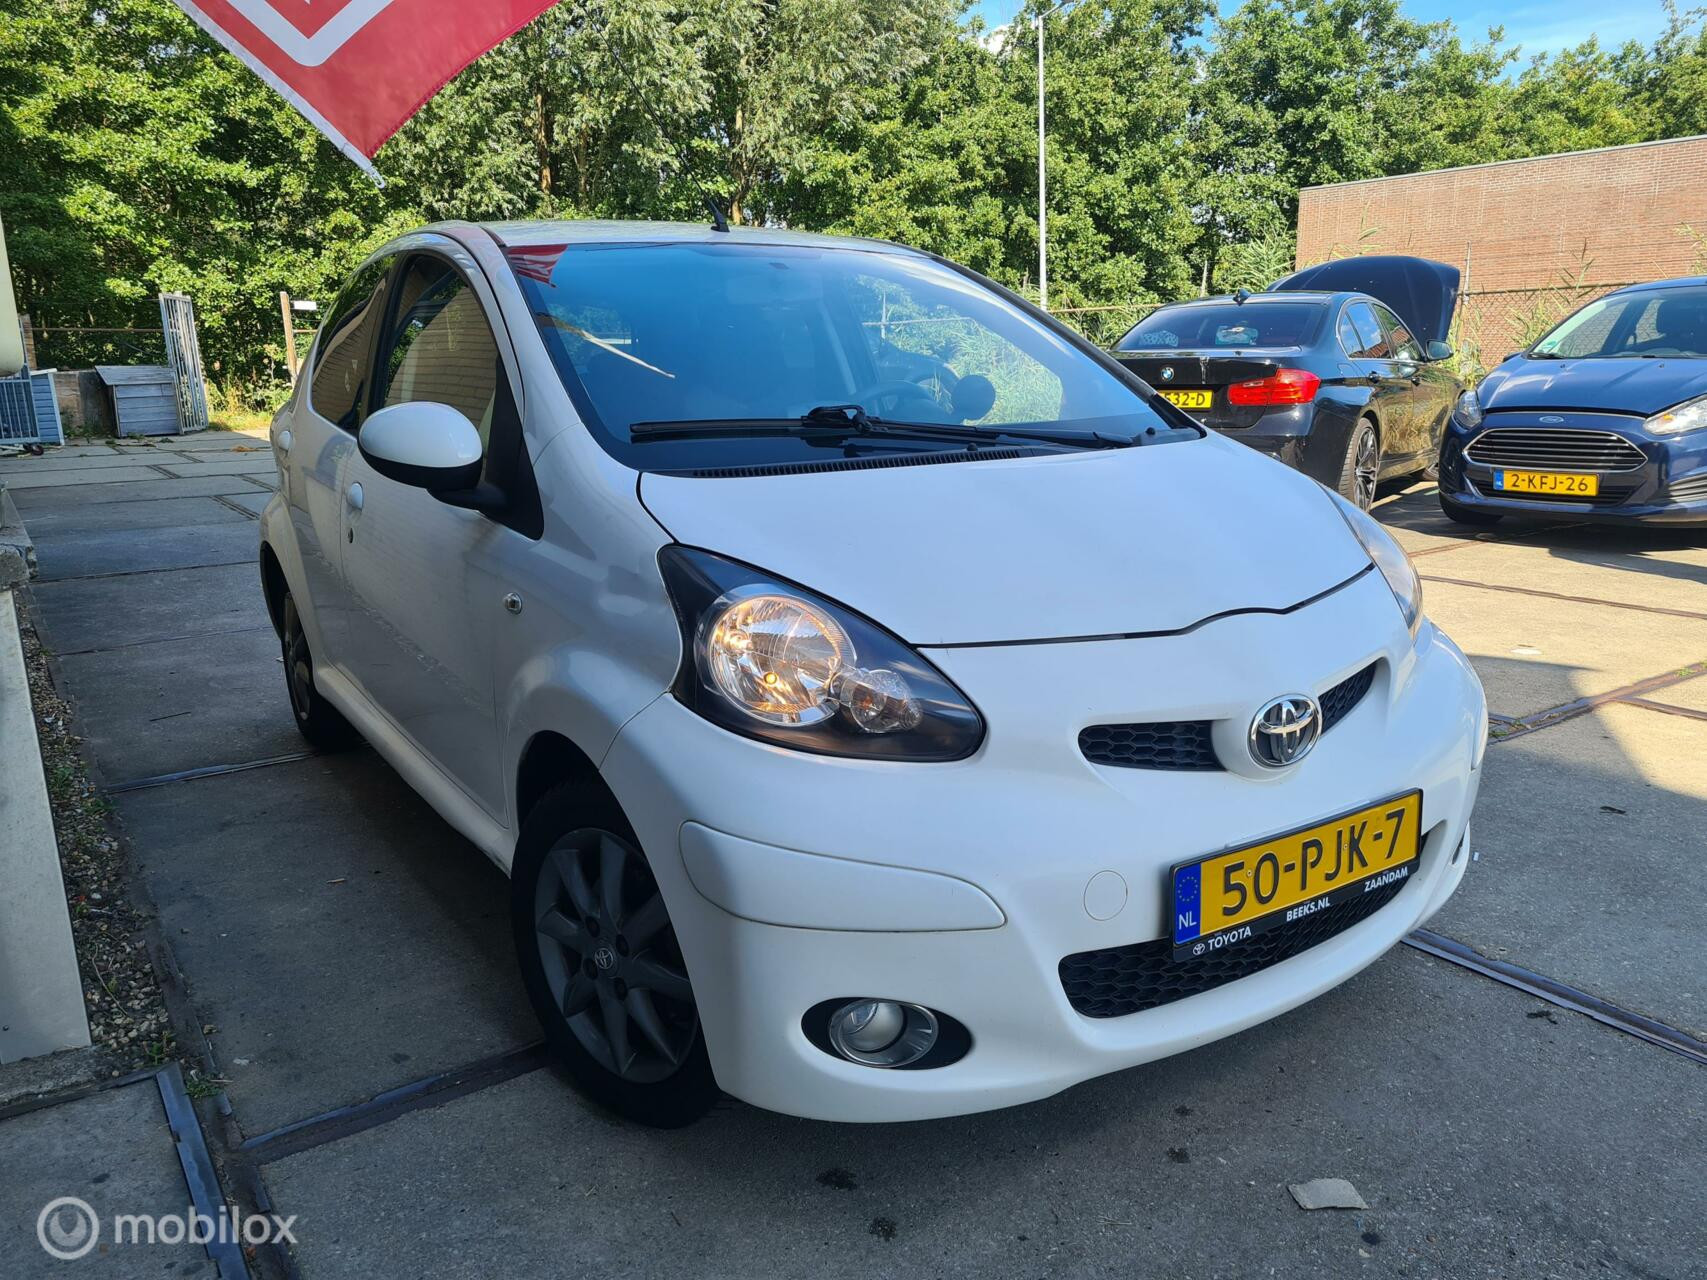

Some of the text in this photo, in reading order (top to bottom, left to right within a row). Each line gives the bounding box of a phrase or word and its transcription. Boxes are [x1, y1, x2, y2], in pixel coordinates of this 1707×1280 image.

[1511, 473, 1588, 492] 2-KFJ-26
[1222, 808, 1405, 917] 50-PJK-7
[1178, 911, 1197, 930] NL
[1207, 867, 1408, 951] TOYOTA BEEKS.NL ZAANDAM
